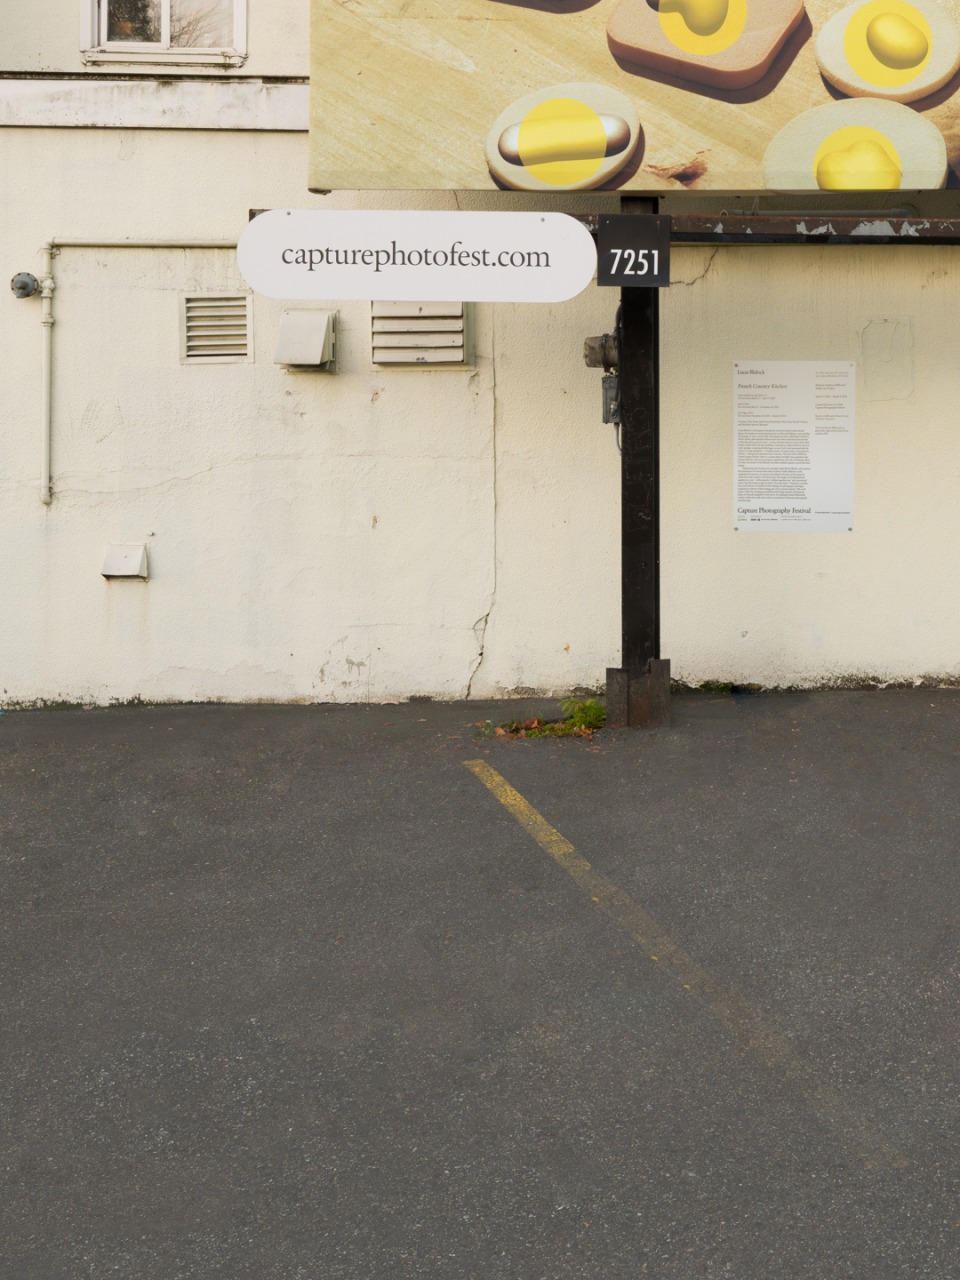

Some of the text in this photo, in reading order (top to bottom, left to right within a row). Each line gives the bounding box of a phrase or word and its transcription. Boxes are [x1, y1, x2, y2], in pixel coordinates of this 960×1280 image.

[281, 241, 551, 273] capturephotofest.com
[610, 249, 659, 275] 7251
[737, 507, 758, 515] Capture
[759, 507, 790, 515] Photography
